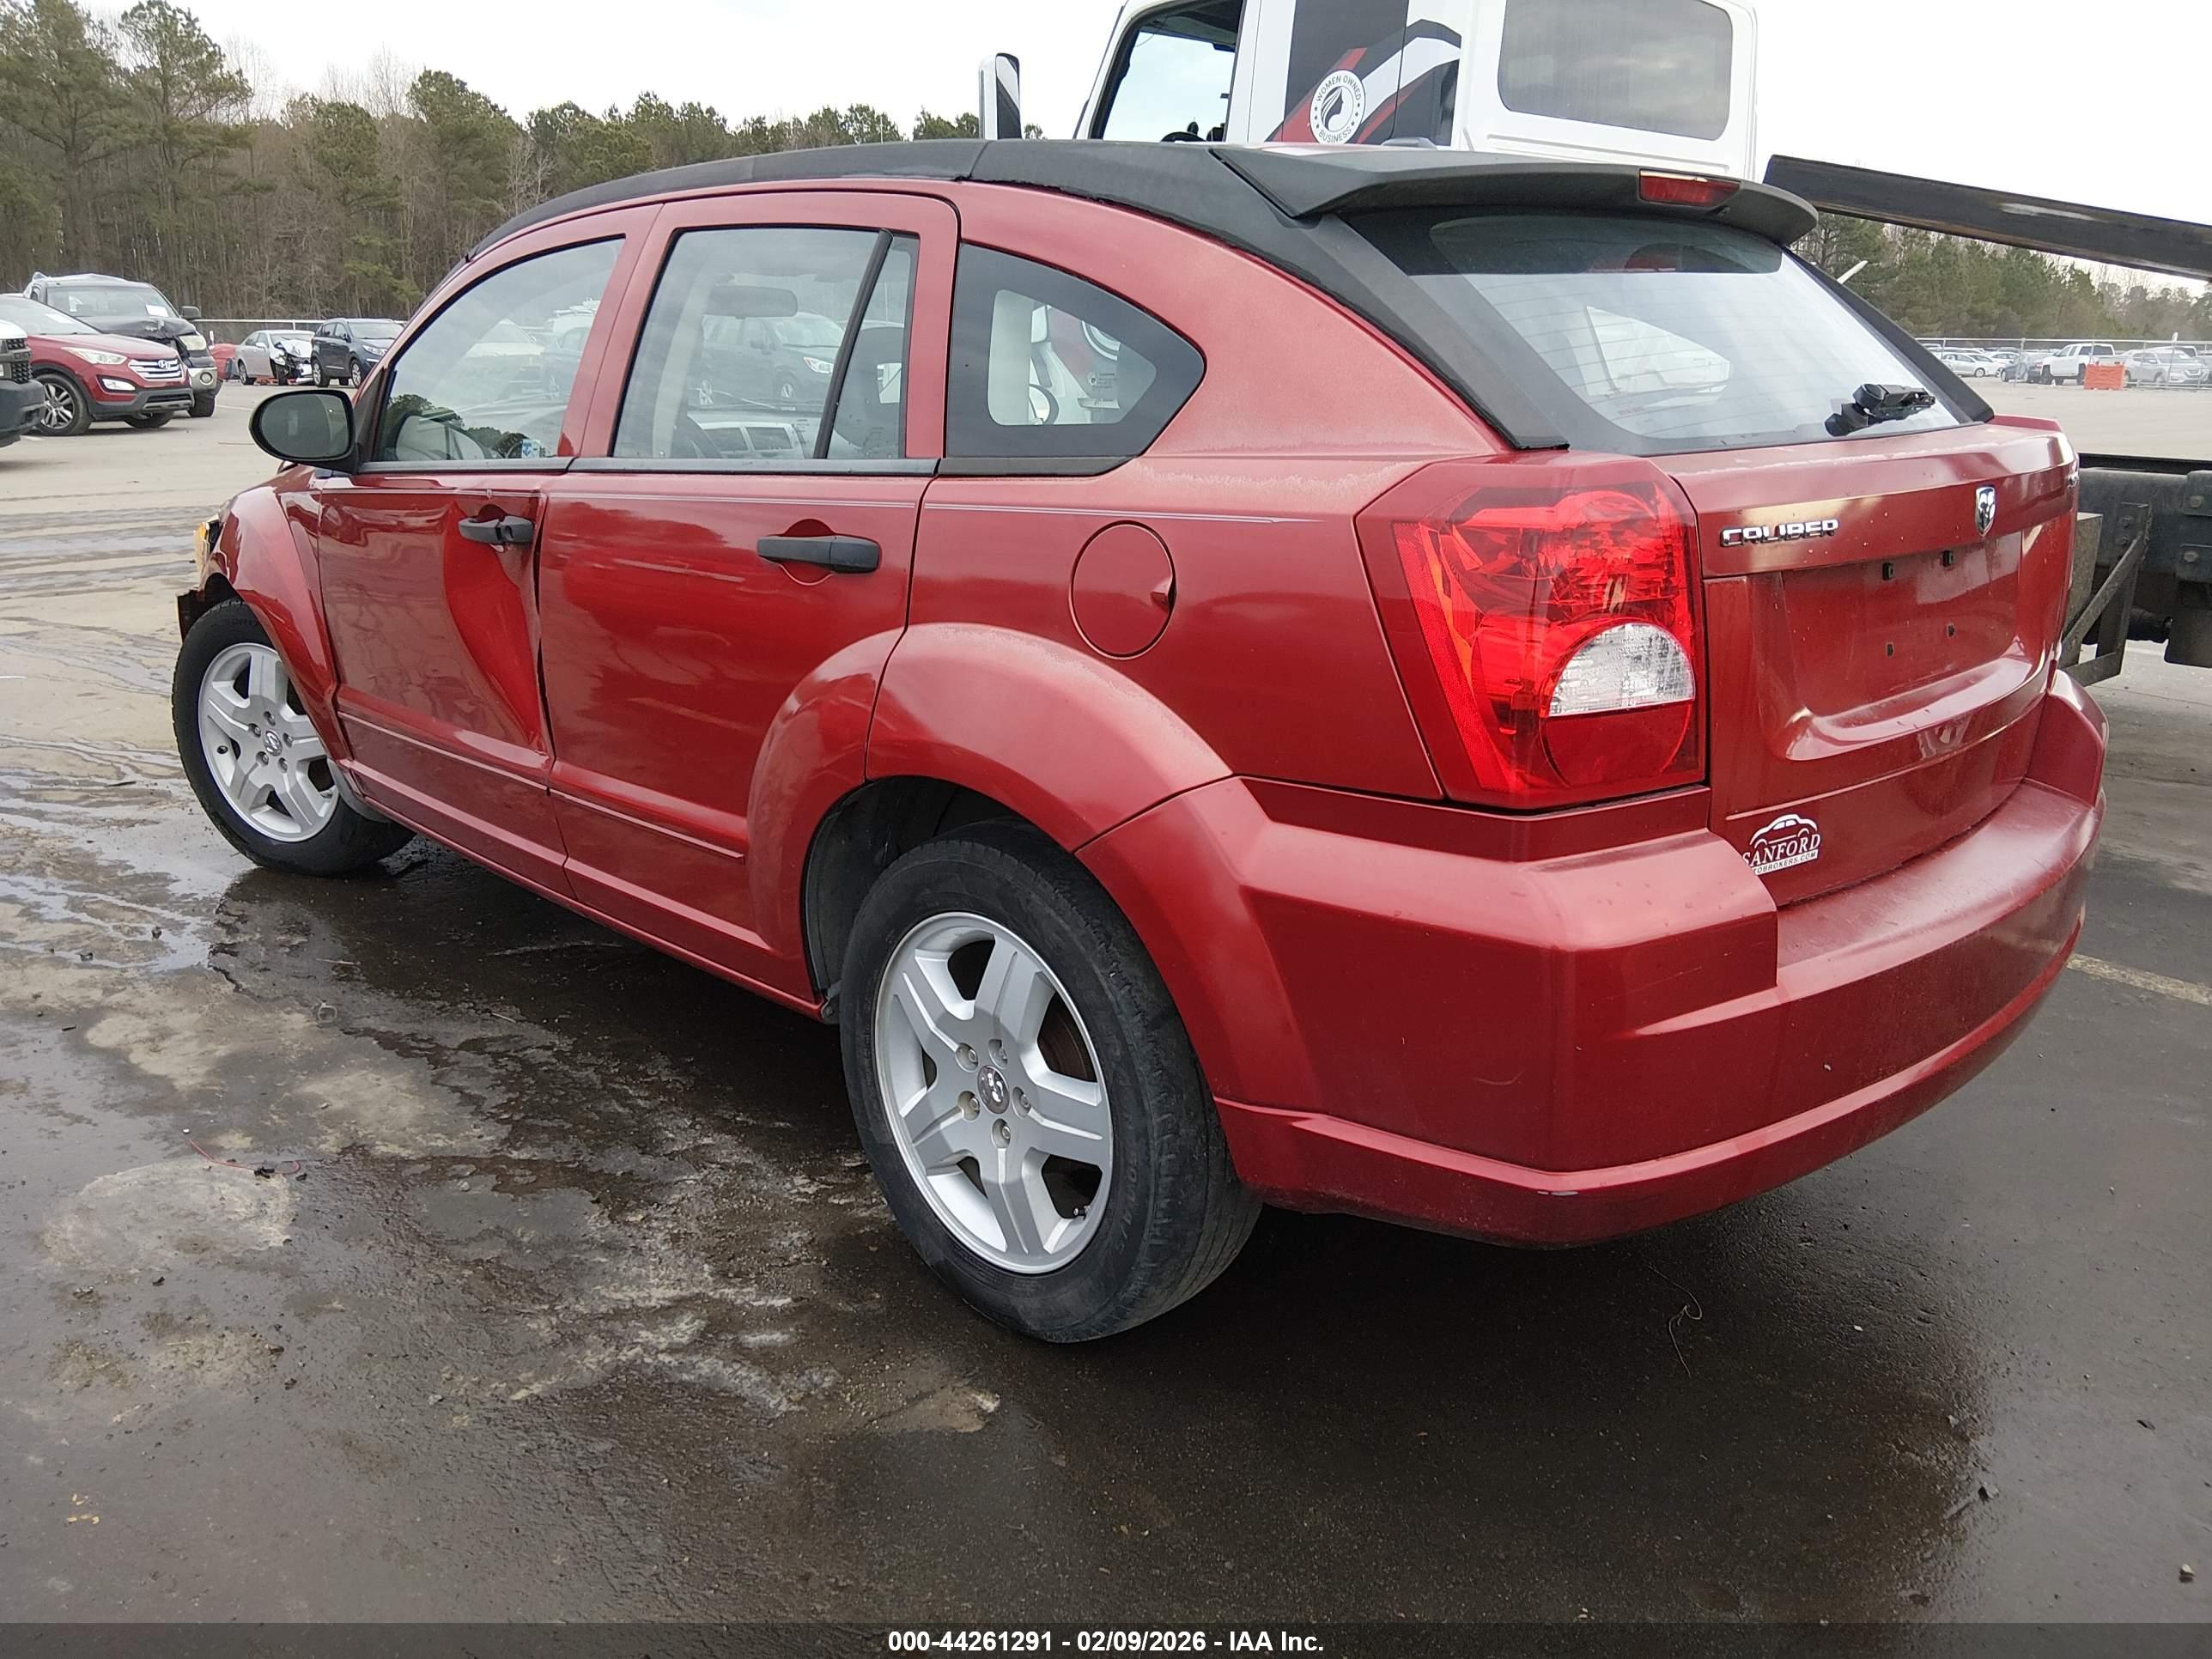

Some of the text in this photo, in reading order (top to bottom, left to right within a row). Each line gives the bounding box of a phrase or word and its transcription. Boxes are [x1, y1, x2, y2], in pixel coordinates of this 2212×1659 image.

[1316, 75, 1362, 102] WOMEN OWNED
[1318, 126, 1352, 143] BUSINESS
[1720, 519, 1839, 547] CALIBER
[1742, 834, 1821, 866] SANFORD
